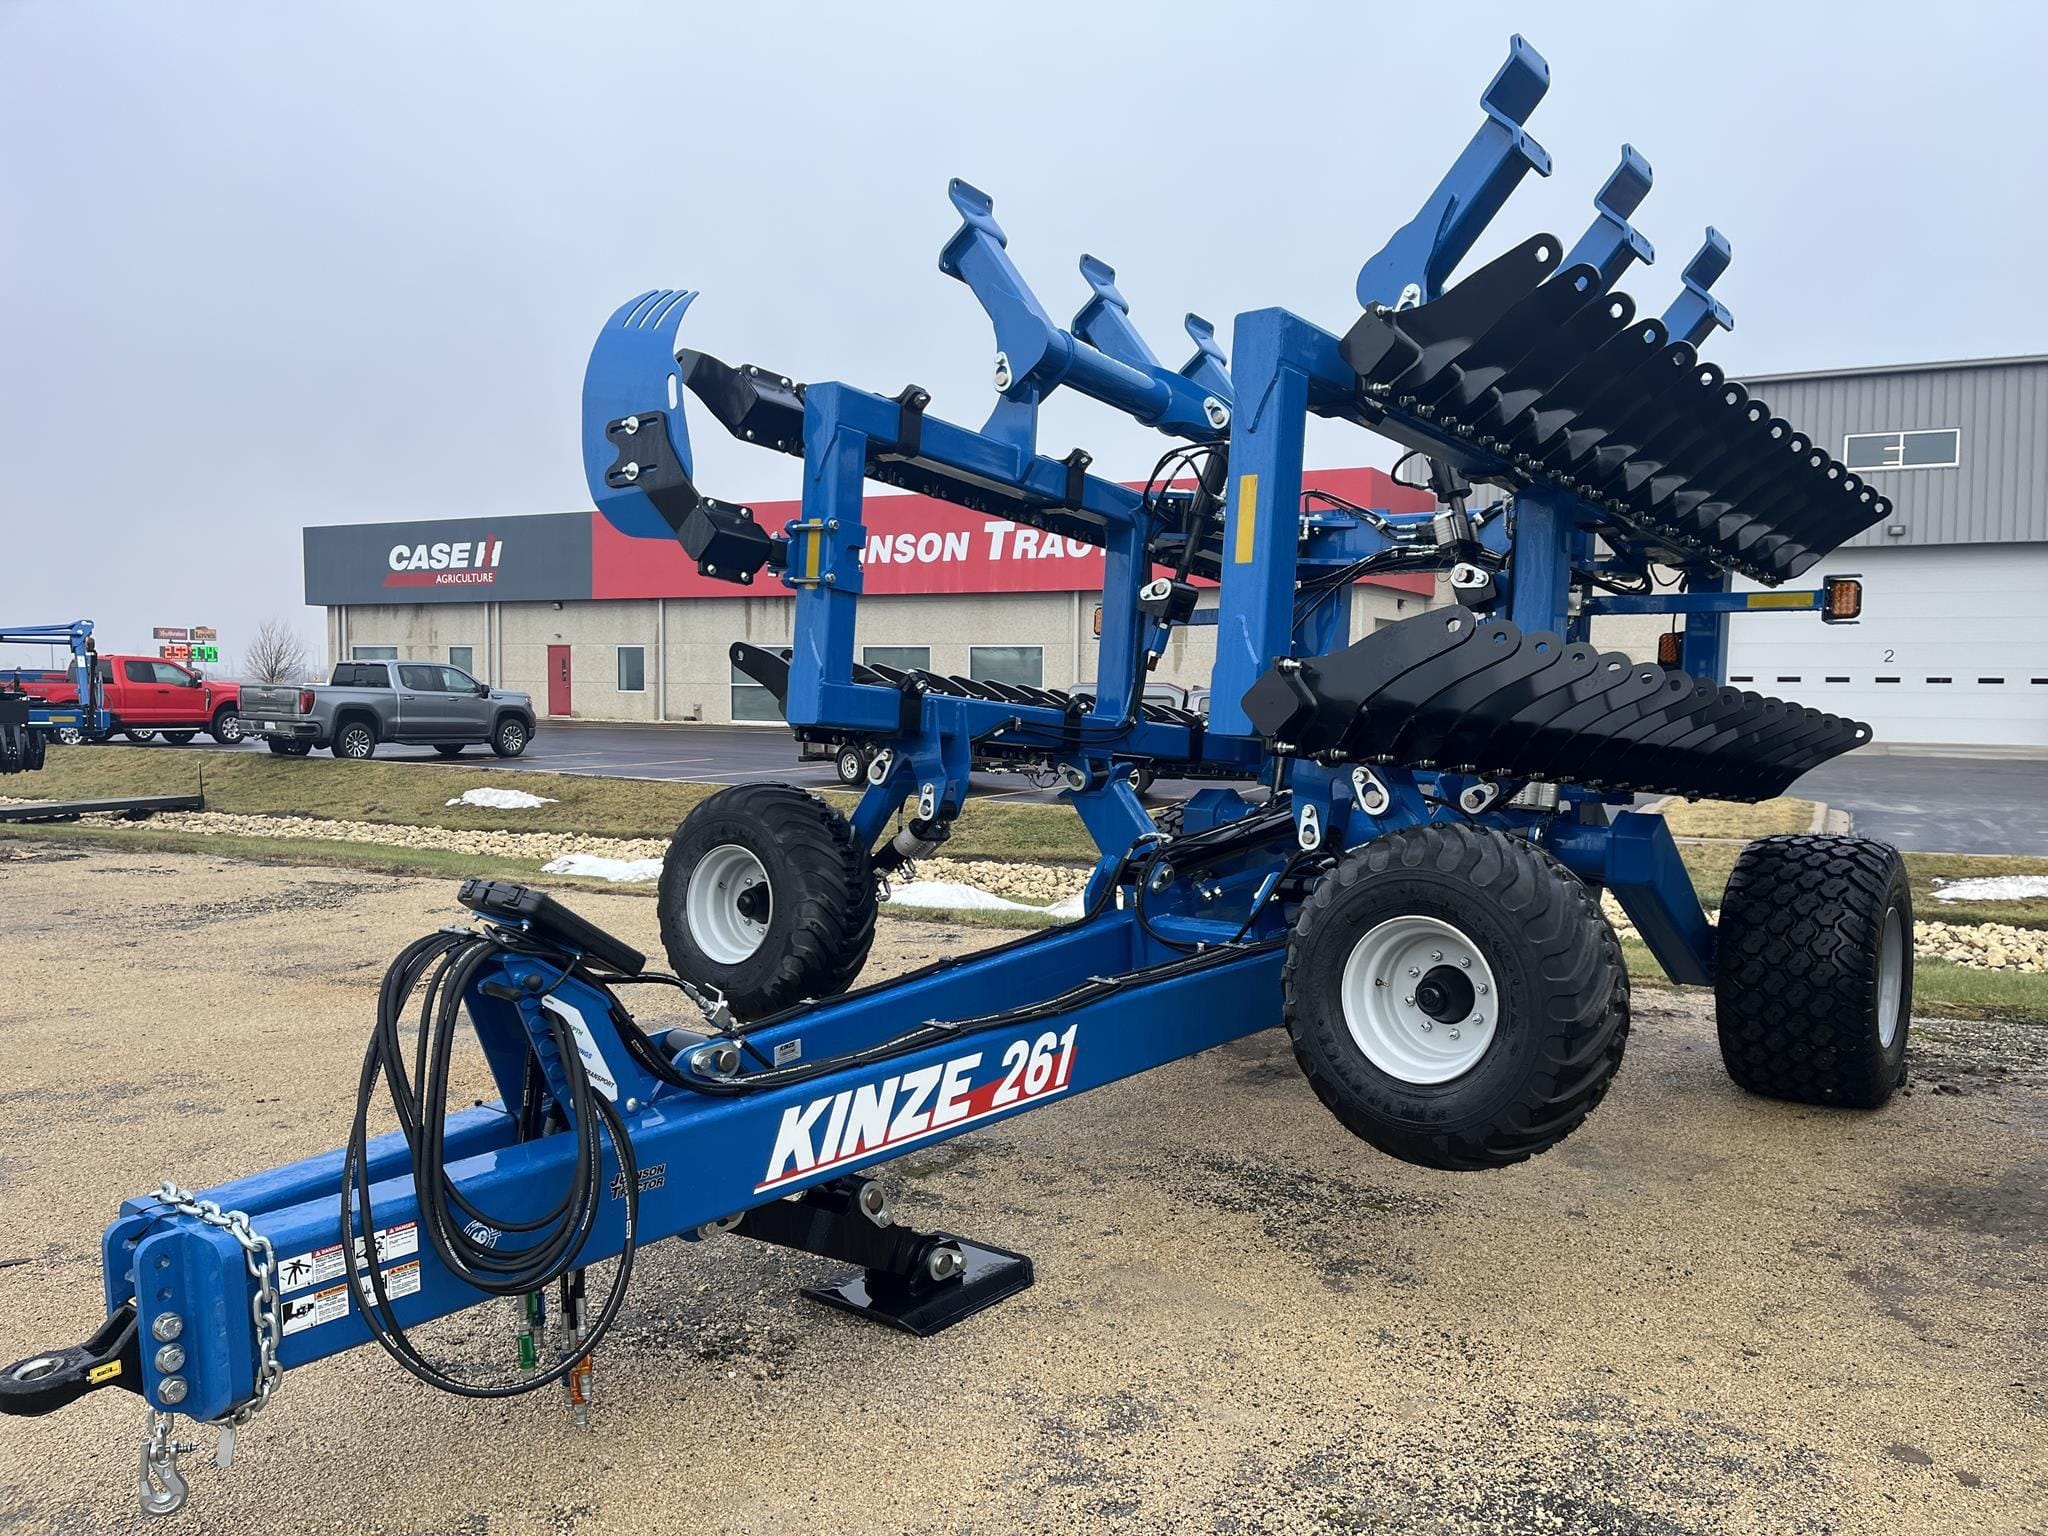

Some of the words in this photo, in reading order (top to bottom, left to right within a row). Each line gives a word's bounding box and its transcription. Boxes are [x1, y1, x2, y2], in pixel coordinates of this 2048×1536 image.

[984, 520, 1106, 560] TRAC
[389, 542, 471, 571] CASE
[435, 573, 493, 584] AGRICULTURE
[1884, 649, 1895, 663] 2
[765, 1052, 982, 1182] KINZE
[991, 1023, 1078, 1108] 261
